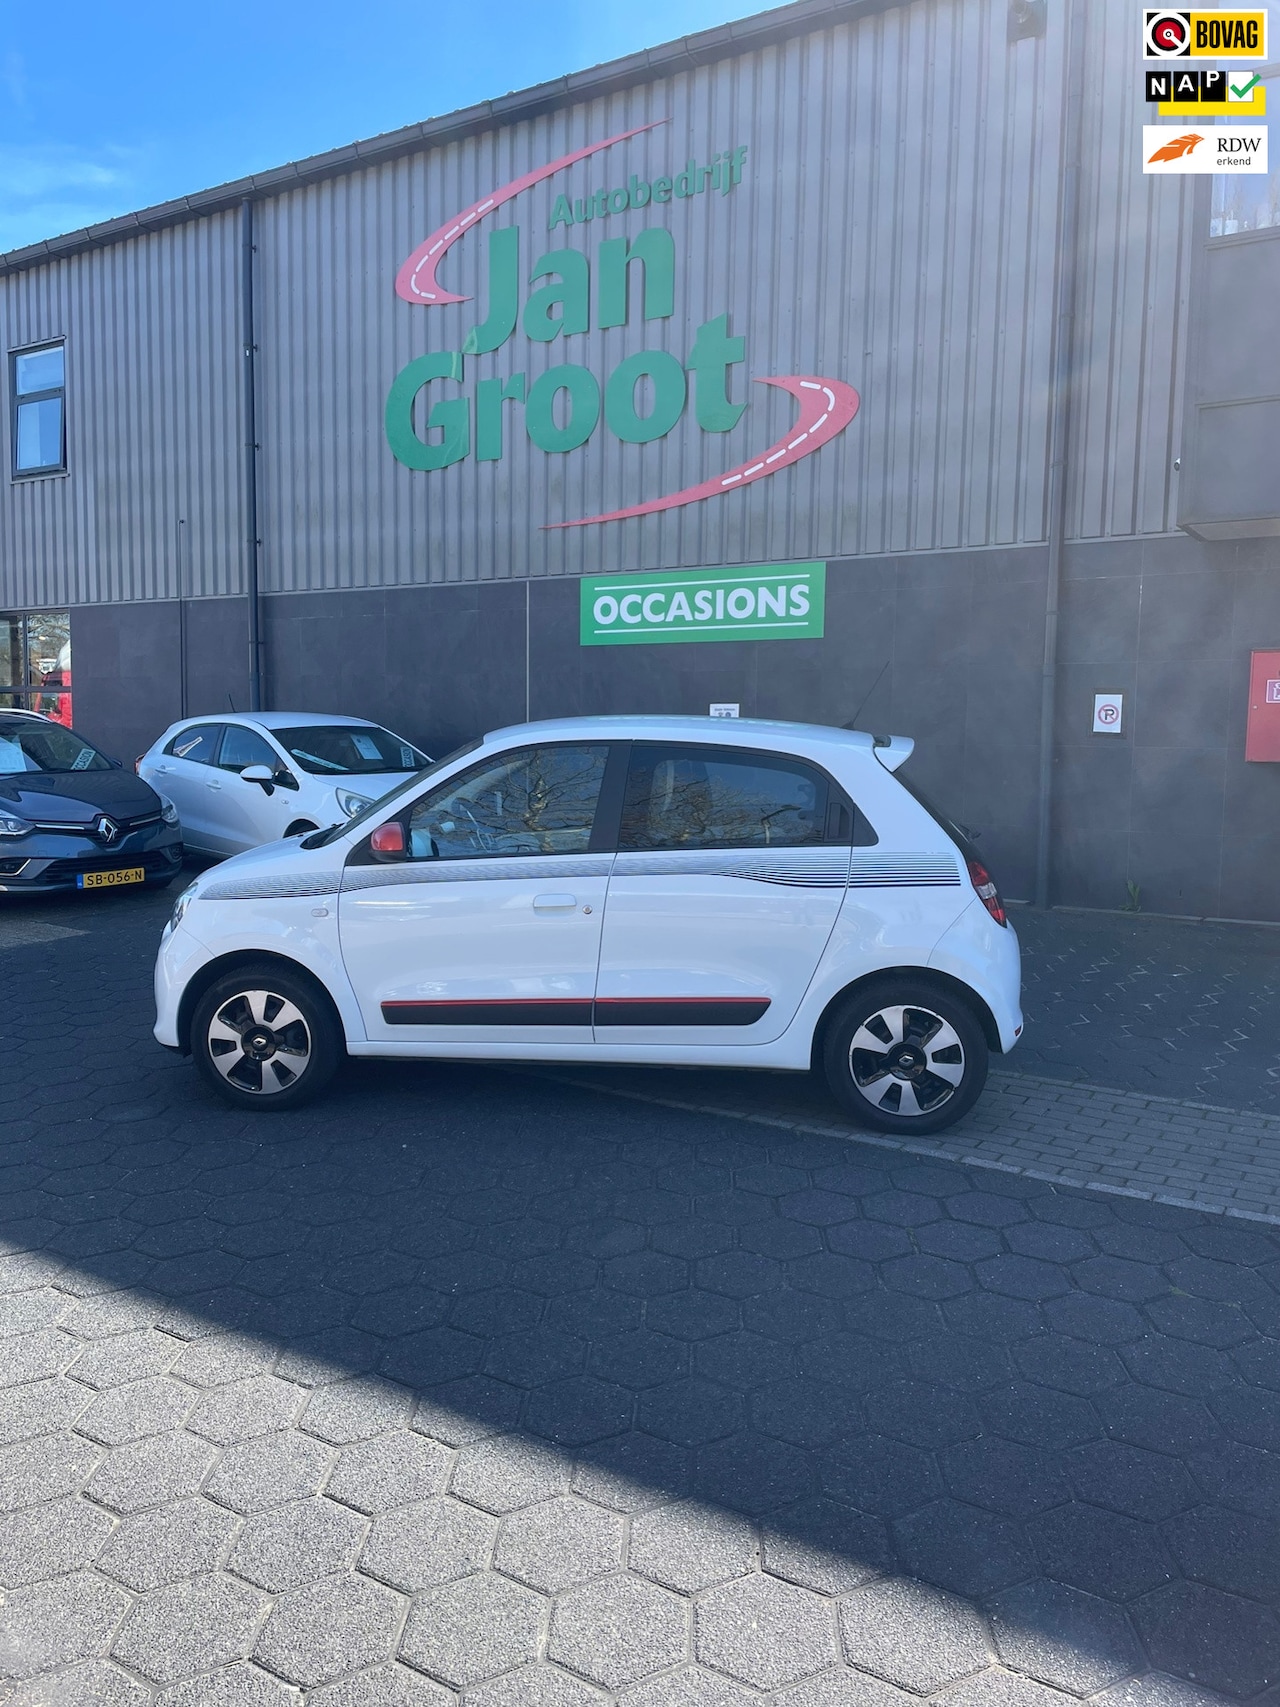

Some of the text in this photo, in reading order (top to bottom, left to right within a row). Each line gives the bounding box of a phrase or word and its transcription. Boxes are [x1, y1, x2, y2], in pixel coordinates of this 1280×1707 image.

[548, 145, 748, 230] Autobedrijf
[463, 225, 675, 355] Jan
[385, 313, 748, 471] Groot
[593, 584, 809, 625] OCCASIONS
[87, 869, 142, 886] SB-056-N
